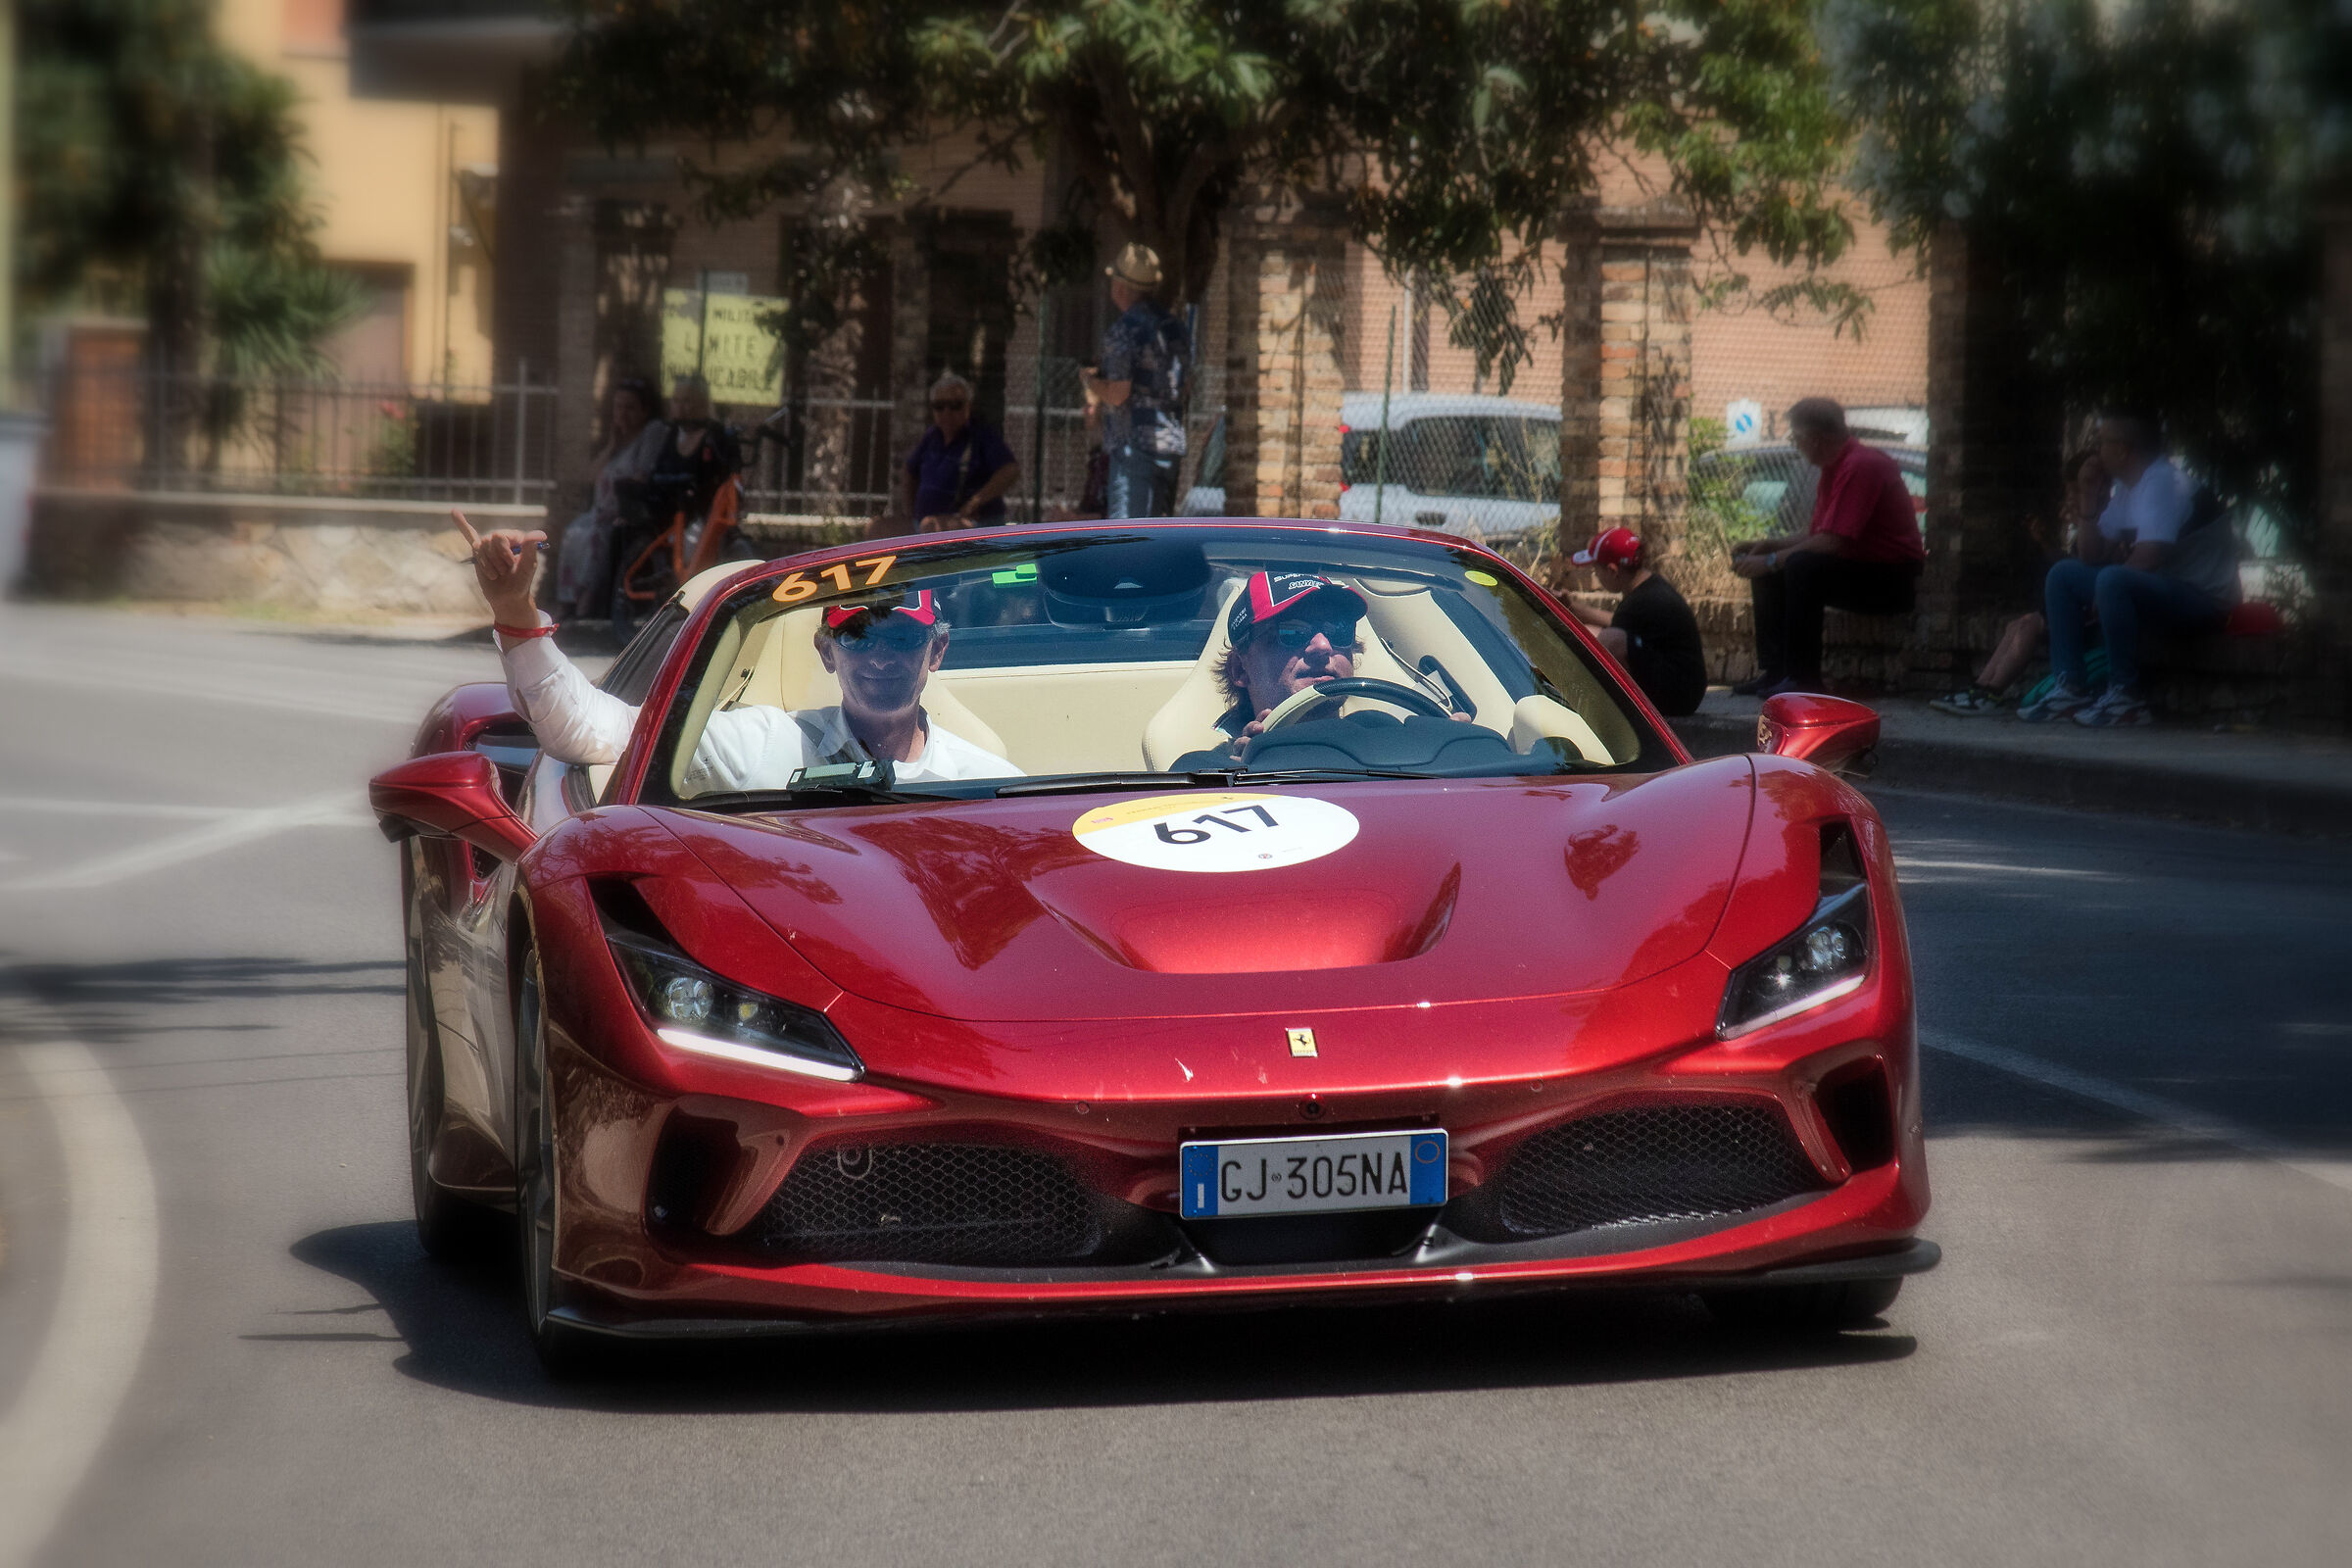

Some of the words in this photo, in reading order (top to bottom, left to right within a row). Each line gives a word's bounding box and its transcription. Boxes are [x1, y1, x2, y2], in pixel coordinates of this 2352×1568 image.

[684, 331, 757, 358] LMITE
[772, 556, 897, 602] 617
[1153, 805, 1279, 845] 617
[1221, 1158, 1267, 1202] GJ
[1287, 1152, 1407, 1200] 305NA
